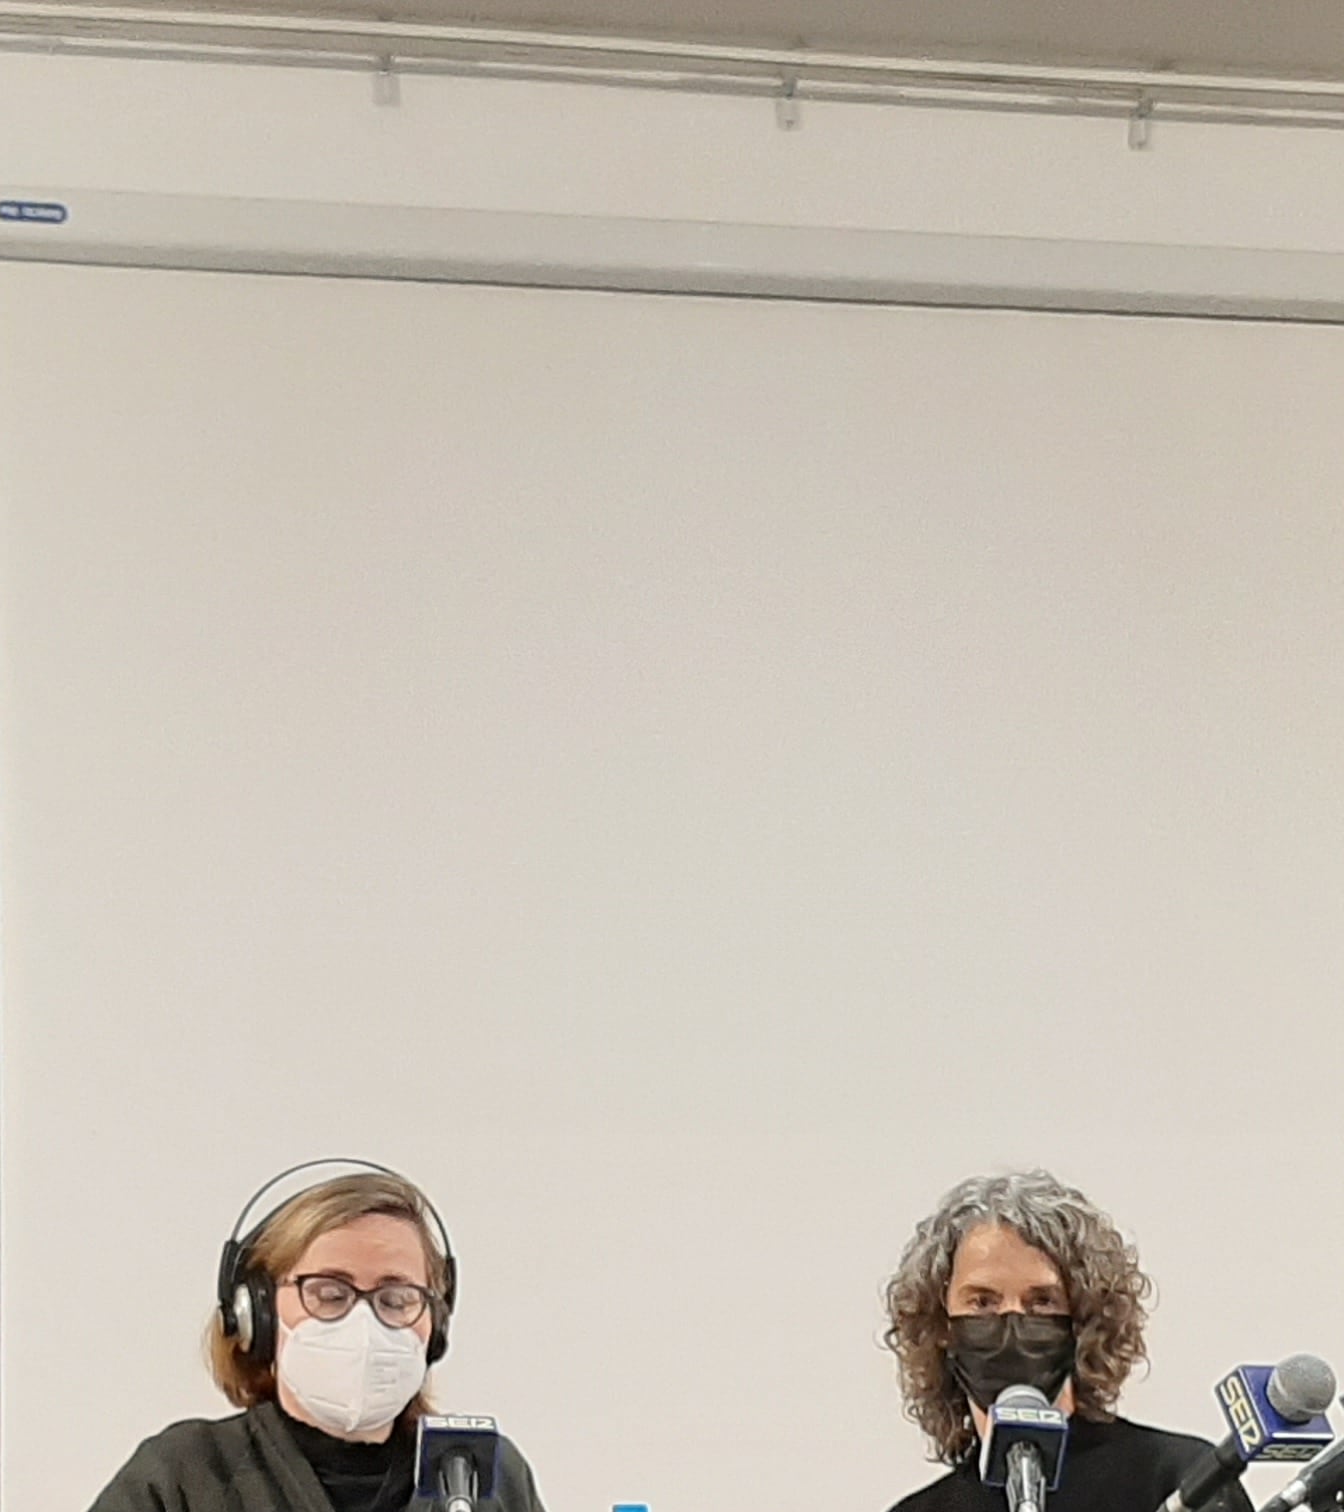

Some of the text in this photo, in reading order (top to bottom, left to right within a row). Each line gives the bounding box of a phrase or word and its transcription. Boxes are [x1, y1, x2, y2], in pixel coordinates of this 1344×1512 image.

[426, 1416, 494, 1429] SER
[995, 1407, 1062, 1424] SER
[1220, 1377, 1261, 1453] SER
